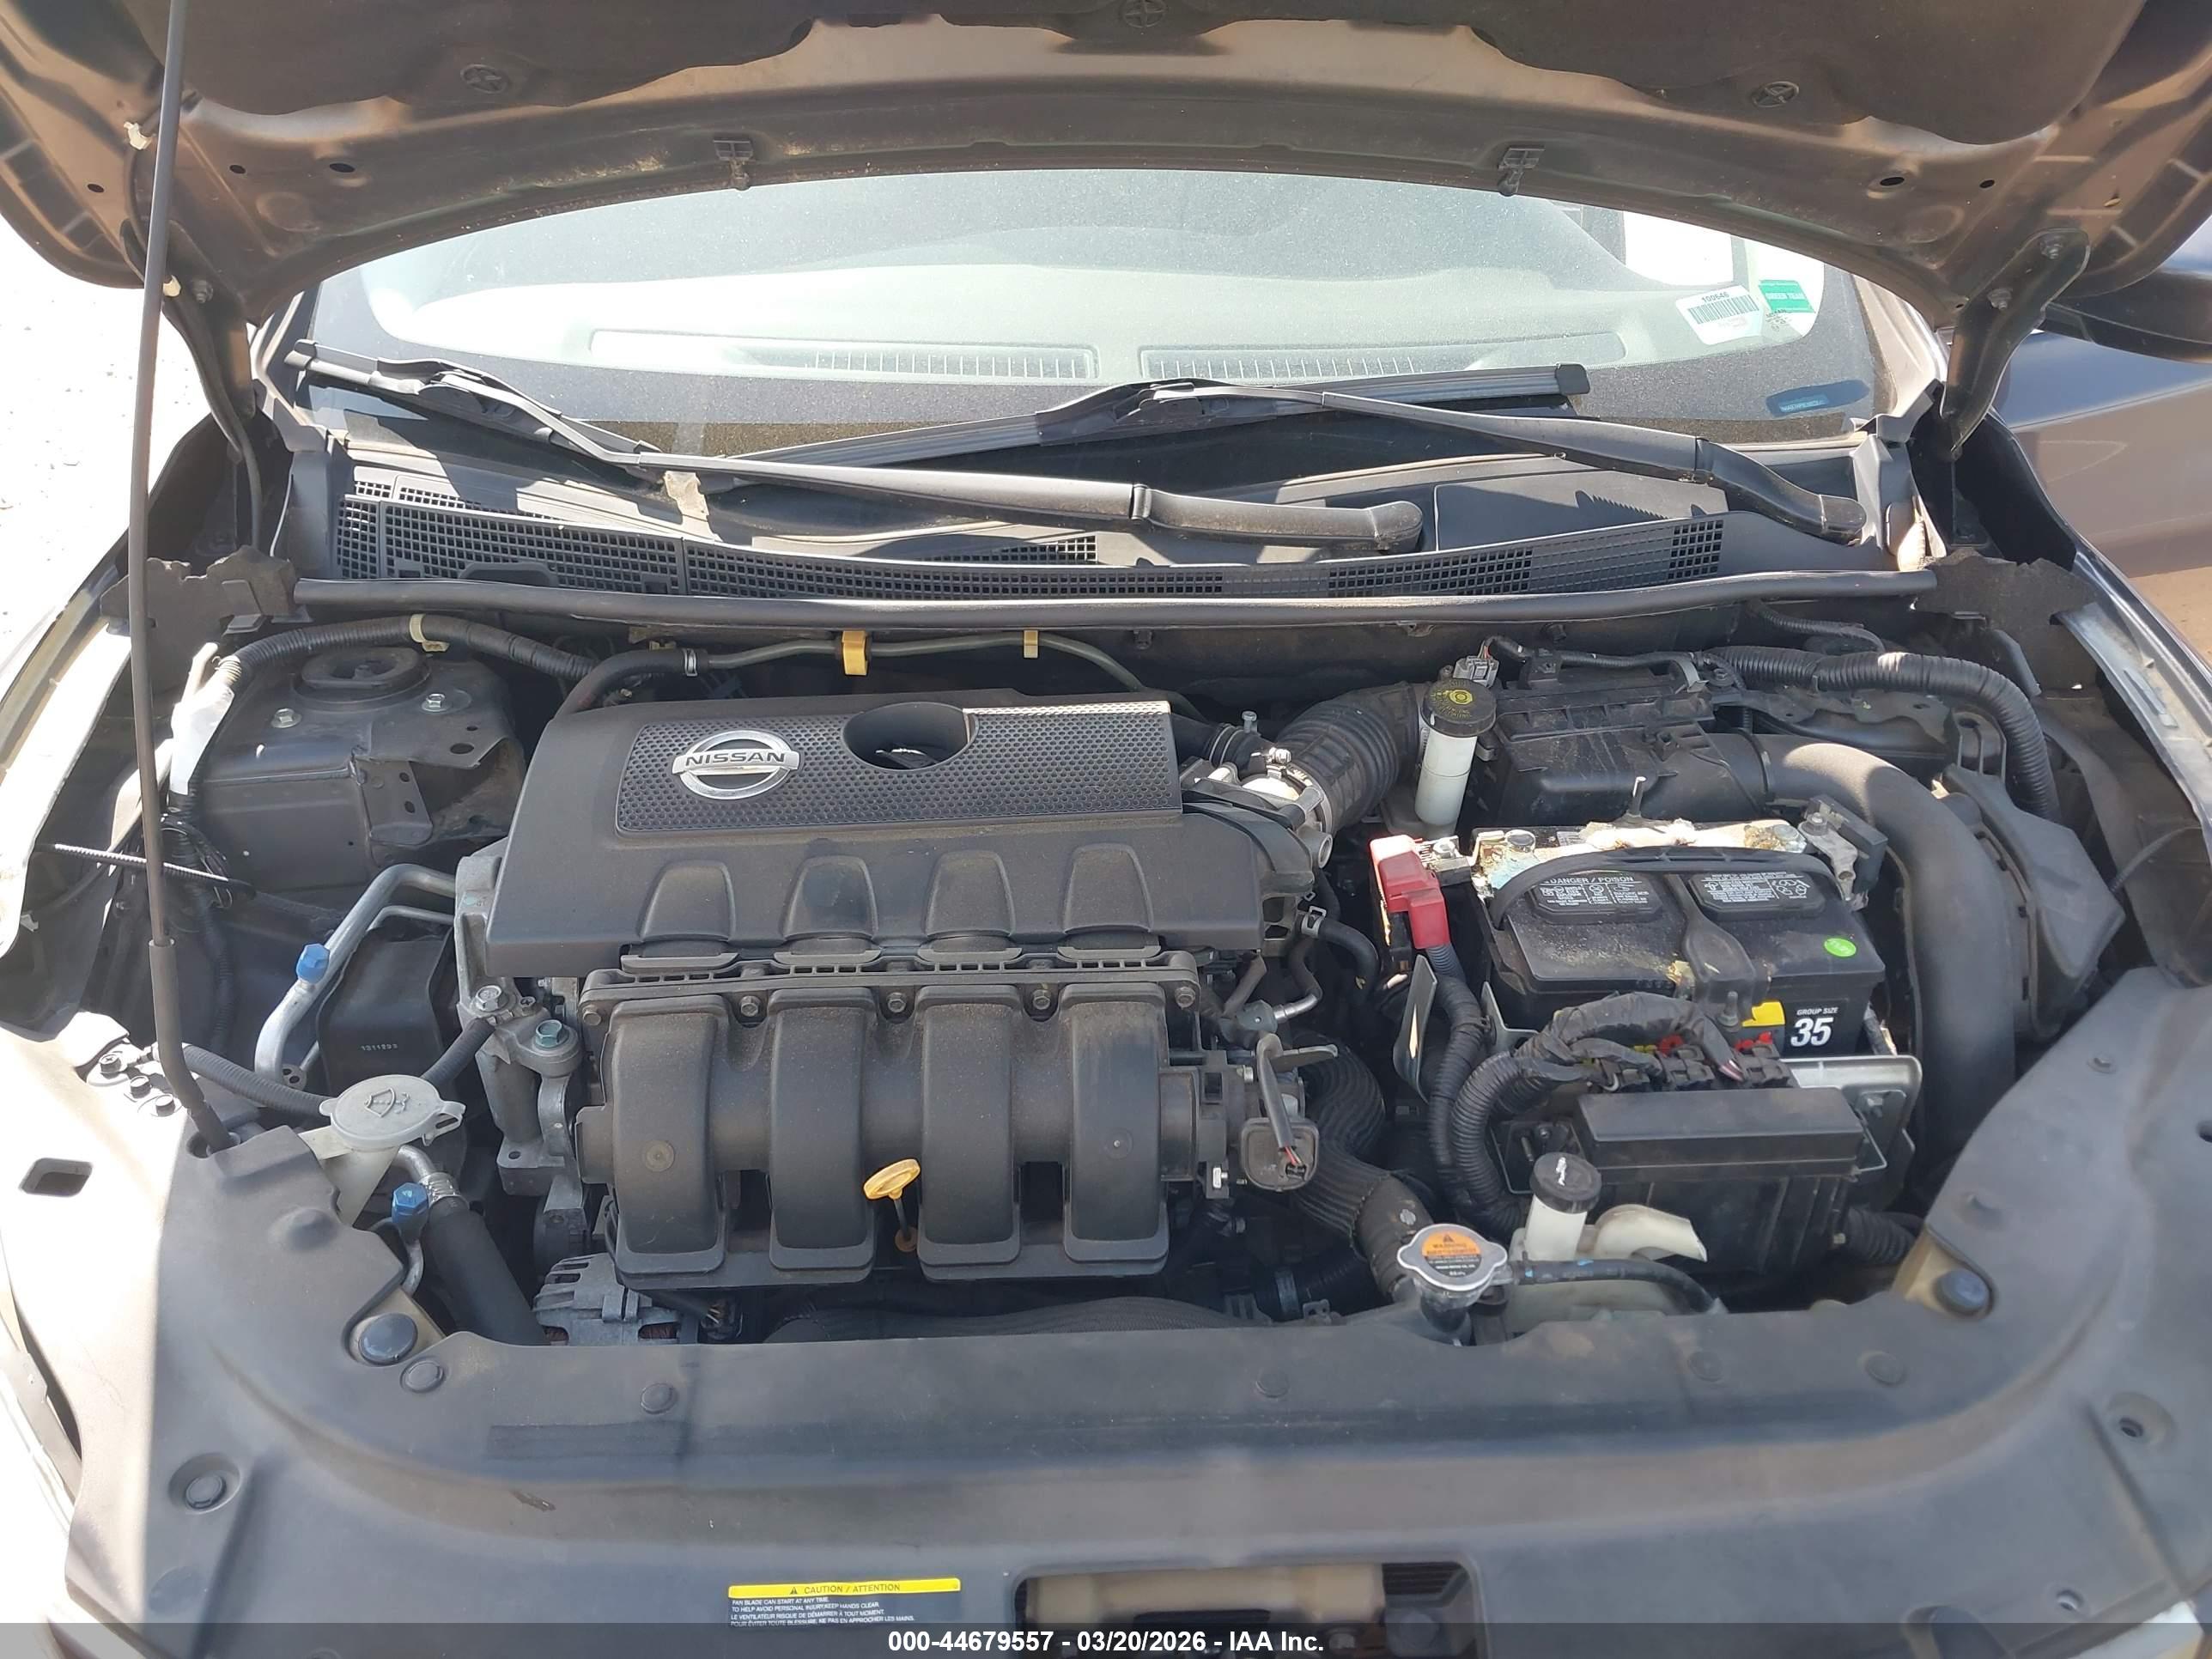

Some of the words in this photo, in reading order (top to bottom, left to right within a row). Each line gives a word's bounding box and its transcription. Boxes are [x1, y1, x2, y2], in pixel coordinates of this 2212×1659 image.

[685, 752, 785, 766] NISSAN
[1790, 1017, 1834, 1047] 35
[804, 1585, 843, 1595] CAUTION
[853, 1583, 901, 1593] ATTENTION
